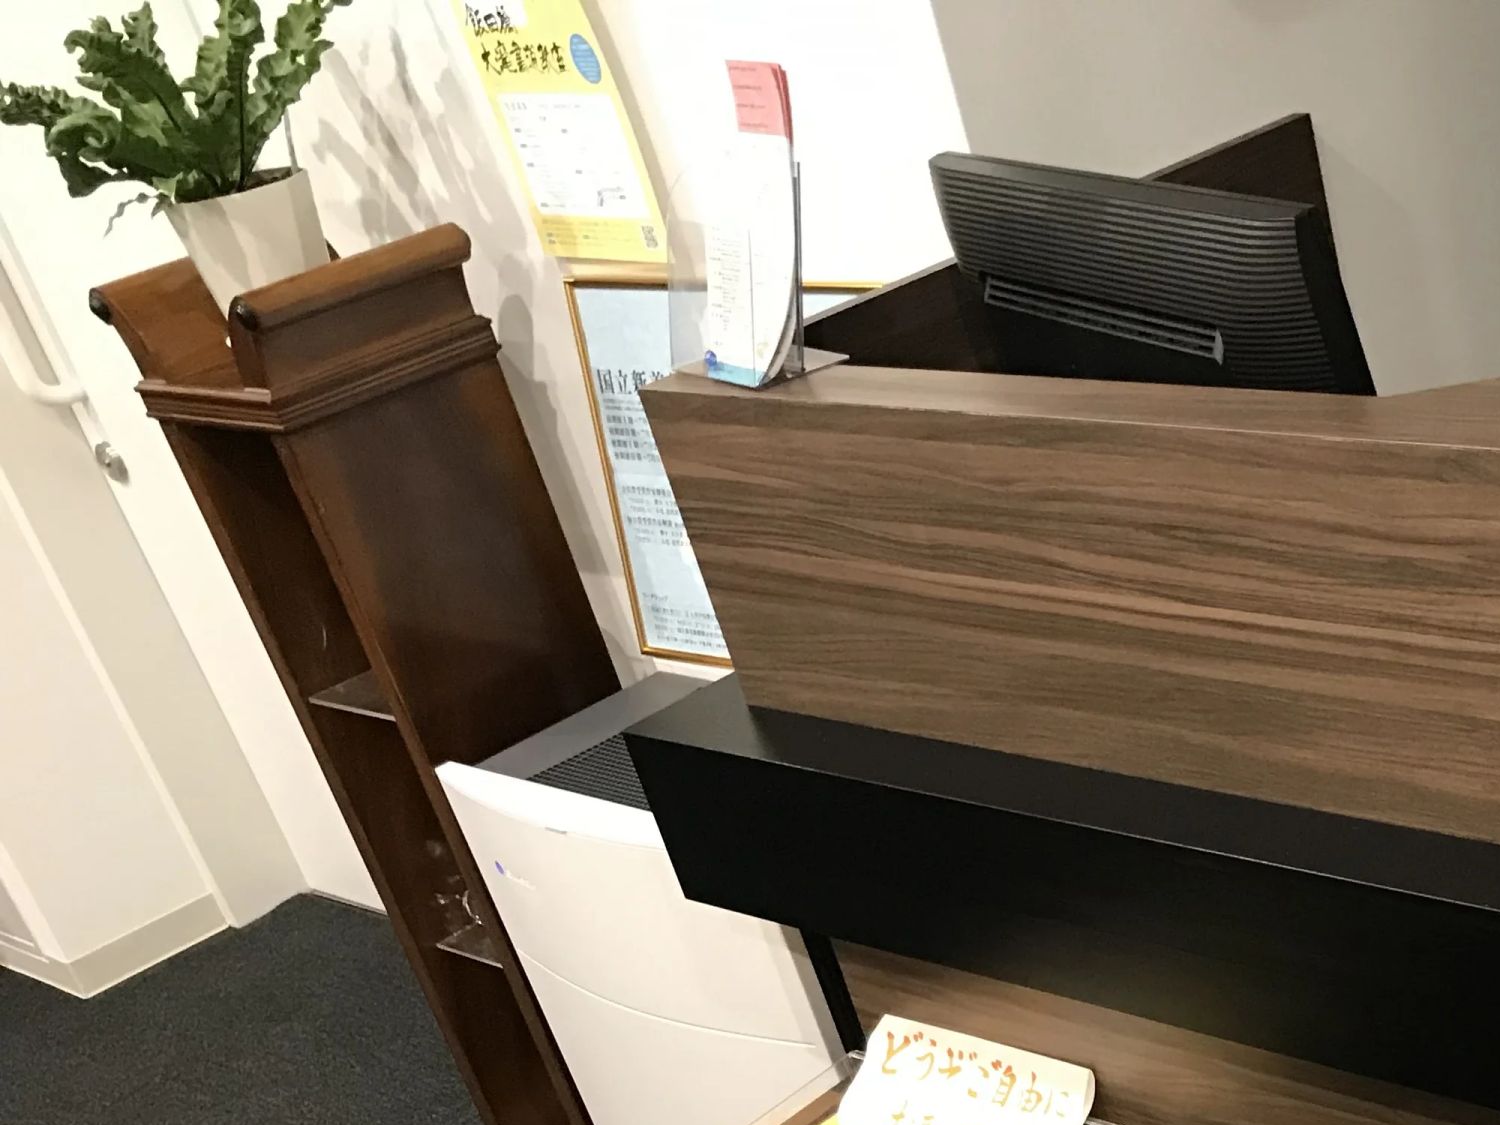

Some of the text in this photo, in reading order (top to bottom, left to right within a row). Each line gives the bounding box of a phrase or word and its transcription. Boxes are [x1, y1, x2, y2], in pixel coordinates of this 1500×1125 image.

[881, 1031, 1069, 1119] どうぞご自由に
